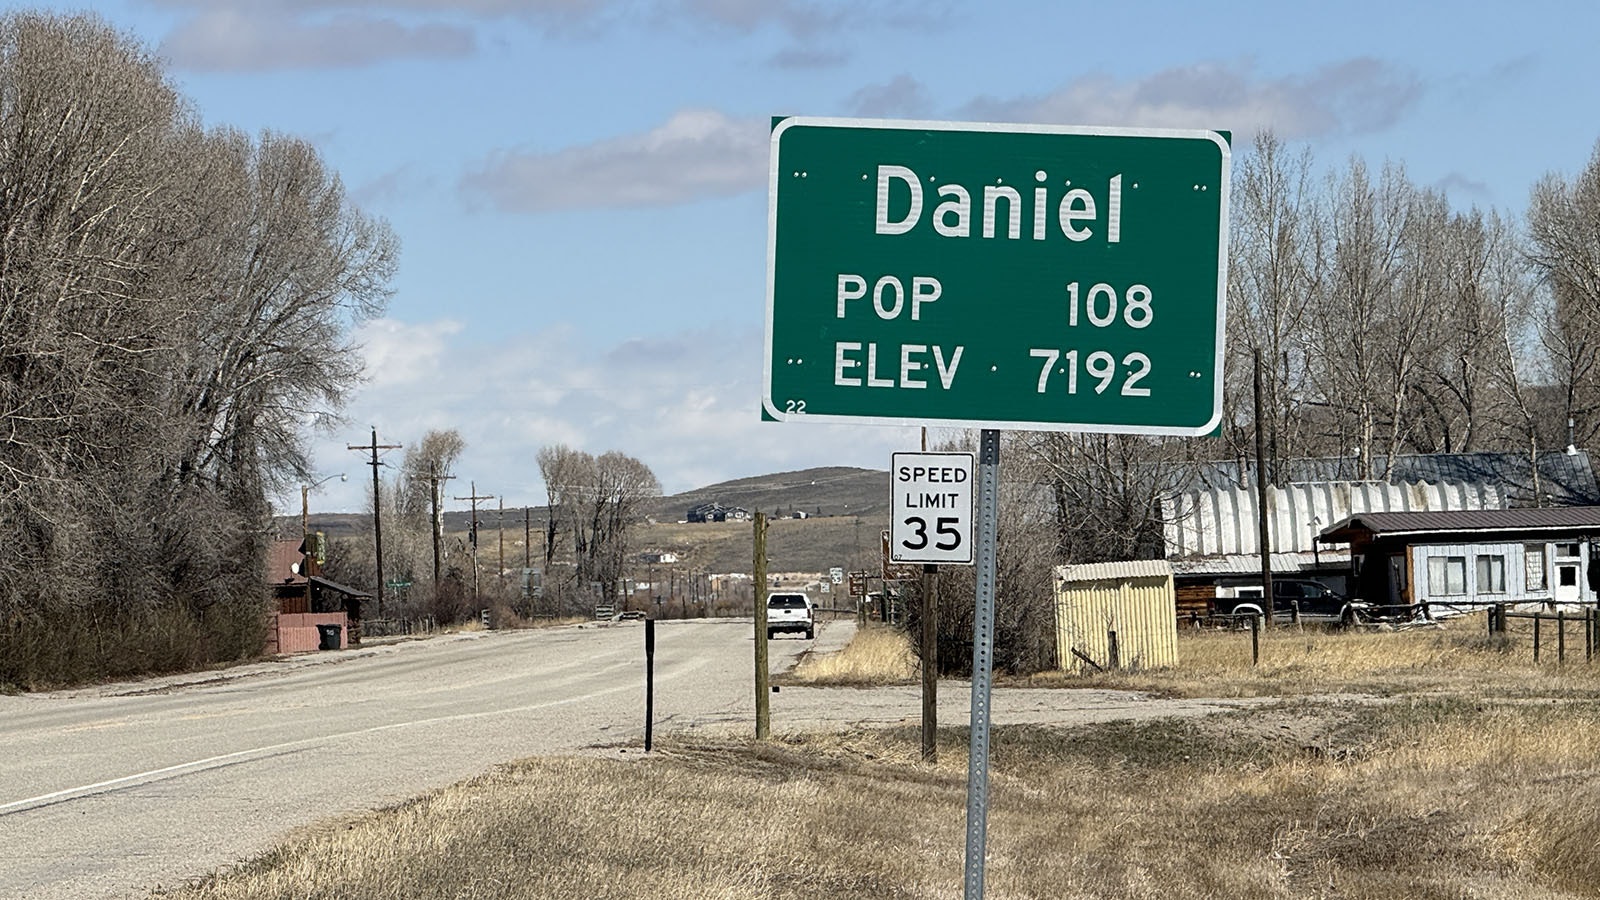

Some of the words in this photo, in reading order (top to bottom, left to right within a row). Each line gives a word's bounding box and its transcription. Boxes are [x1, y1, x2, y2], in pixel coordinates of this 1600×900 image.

[875, 164, 1122, 243] Daniel
[836, 274, 943, 321] POP
[1066, 281, 1154, 329] 108
[834, 341, 964, 390] ELEV
[1029, 348, 1152, 397] 7192
[786, 400, 807, 414] 22
[898, 466, 967, 483] SPEED
[906, 492, 959, 509] LIMIT
[902, 516, 962, 551] 35
